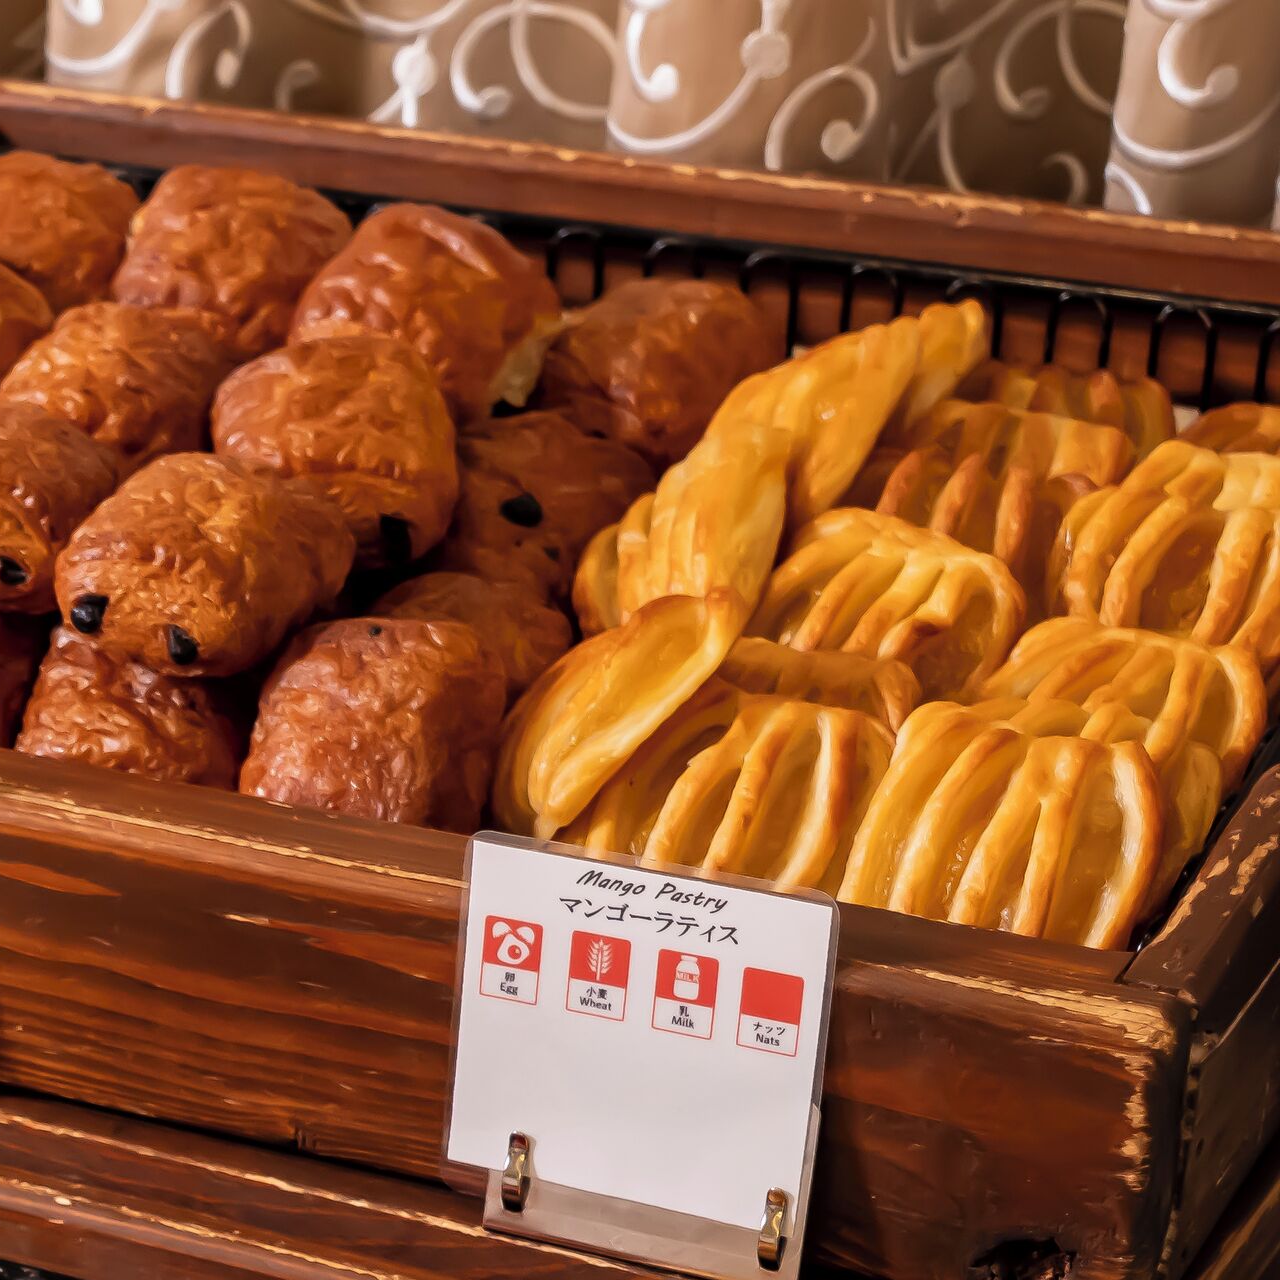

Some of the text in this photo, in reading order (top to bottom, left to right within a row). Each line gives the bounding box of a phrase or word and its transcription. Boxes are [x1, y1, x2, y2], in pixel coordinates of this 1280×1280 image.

[576, 869, 730, 914] Mango Pastry
[559, 896, 739, 945] マンゴーラティス
[504, 971, 515, 982] 卵
[500, 982, 518, 996] Egg
[586, 986, 608, 1000] 小麦
[579, 997, 612, 1011] Wheat
[679, 1005, 690, 1017] 乳
[671, 1016, 694, 1029] Milk
[752, 1021, 786, 1036] ナッツ
[755, 1033, 780, 1047] Nats
